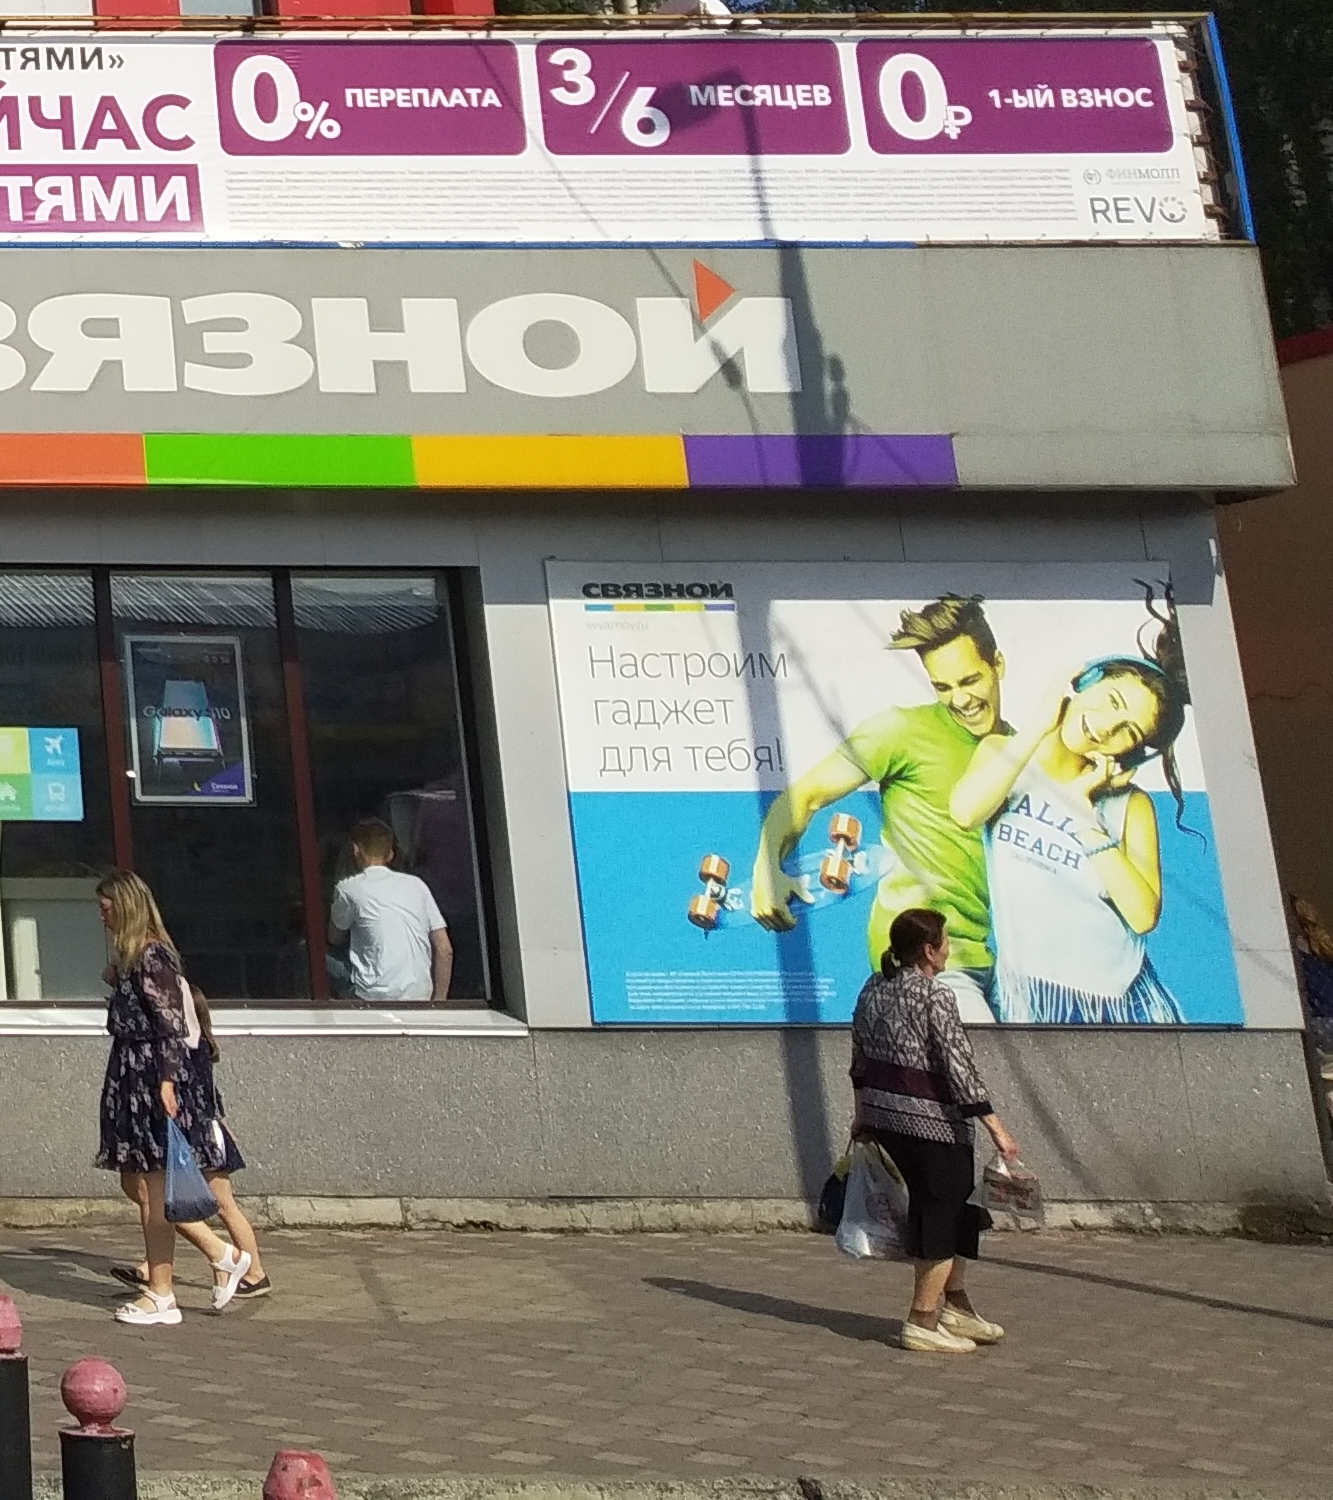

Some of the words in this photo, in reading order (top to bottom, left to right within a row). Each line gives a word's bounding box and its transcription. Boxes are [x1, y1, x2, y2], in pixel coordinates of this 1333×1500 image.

[344, 84, 503, 109] ПЕРЕПЛАТА
[689, 81, 832, 110] МЕСЯЦЕВ
[987, 84, 1055, 109] 1-ЫЙ
[1062, 87, 1155, 109] ВЗНОС
[582, 579, 734, 599] СВЯЗНОЙ
[589, 645, 788, 685] Настроим
[142, 706, 204, 722] Galaxy
[594, 698, 734, 731] гаджет
[599, 744, 672, 777] для
[684, 738, 786, 773] тебя!
[997, 822, 1083, 871] BEACH
